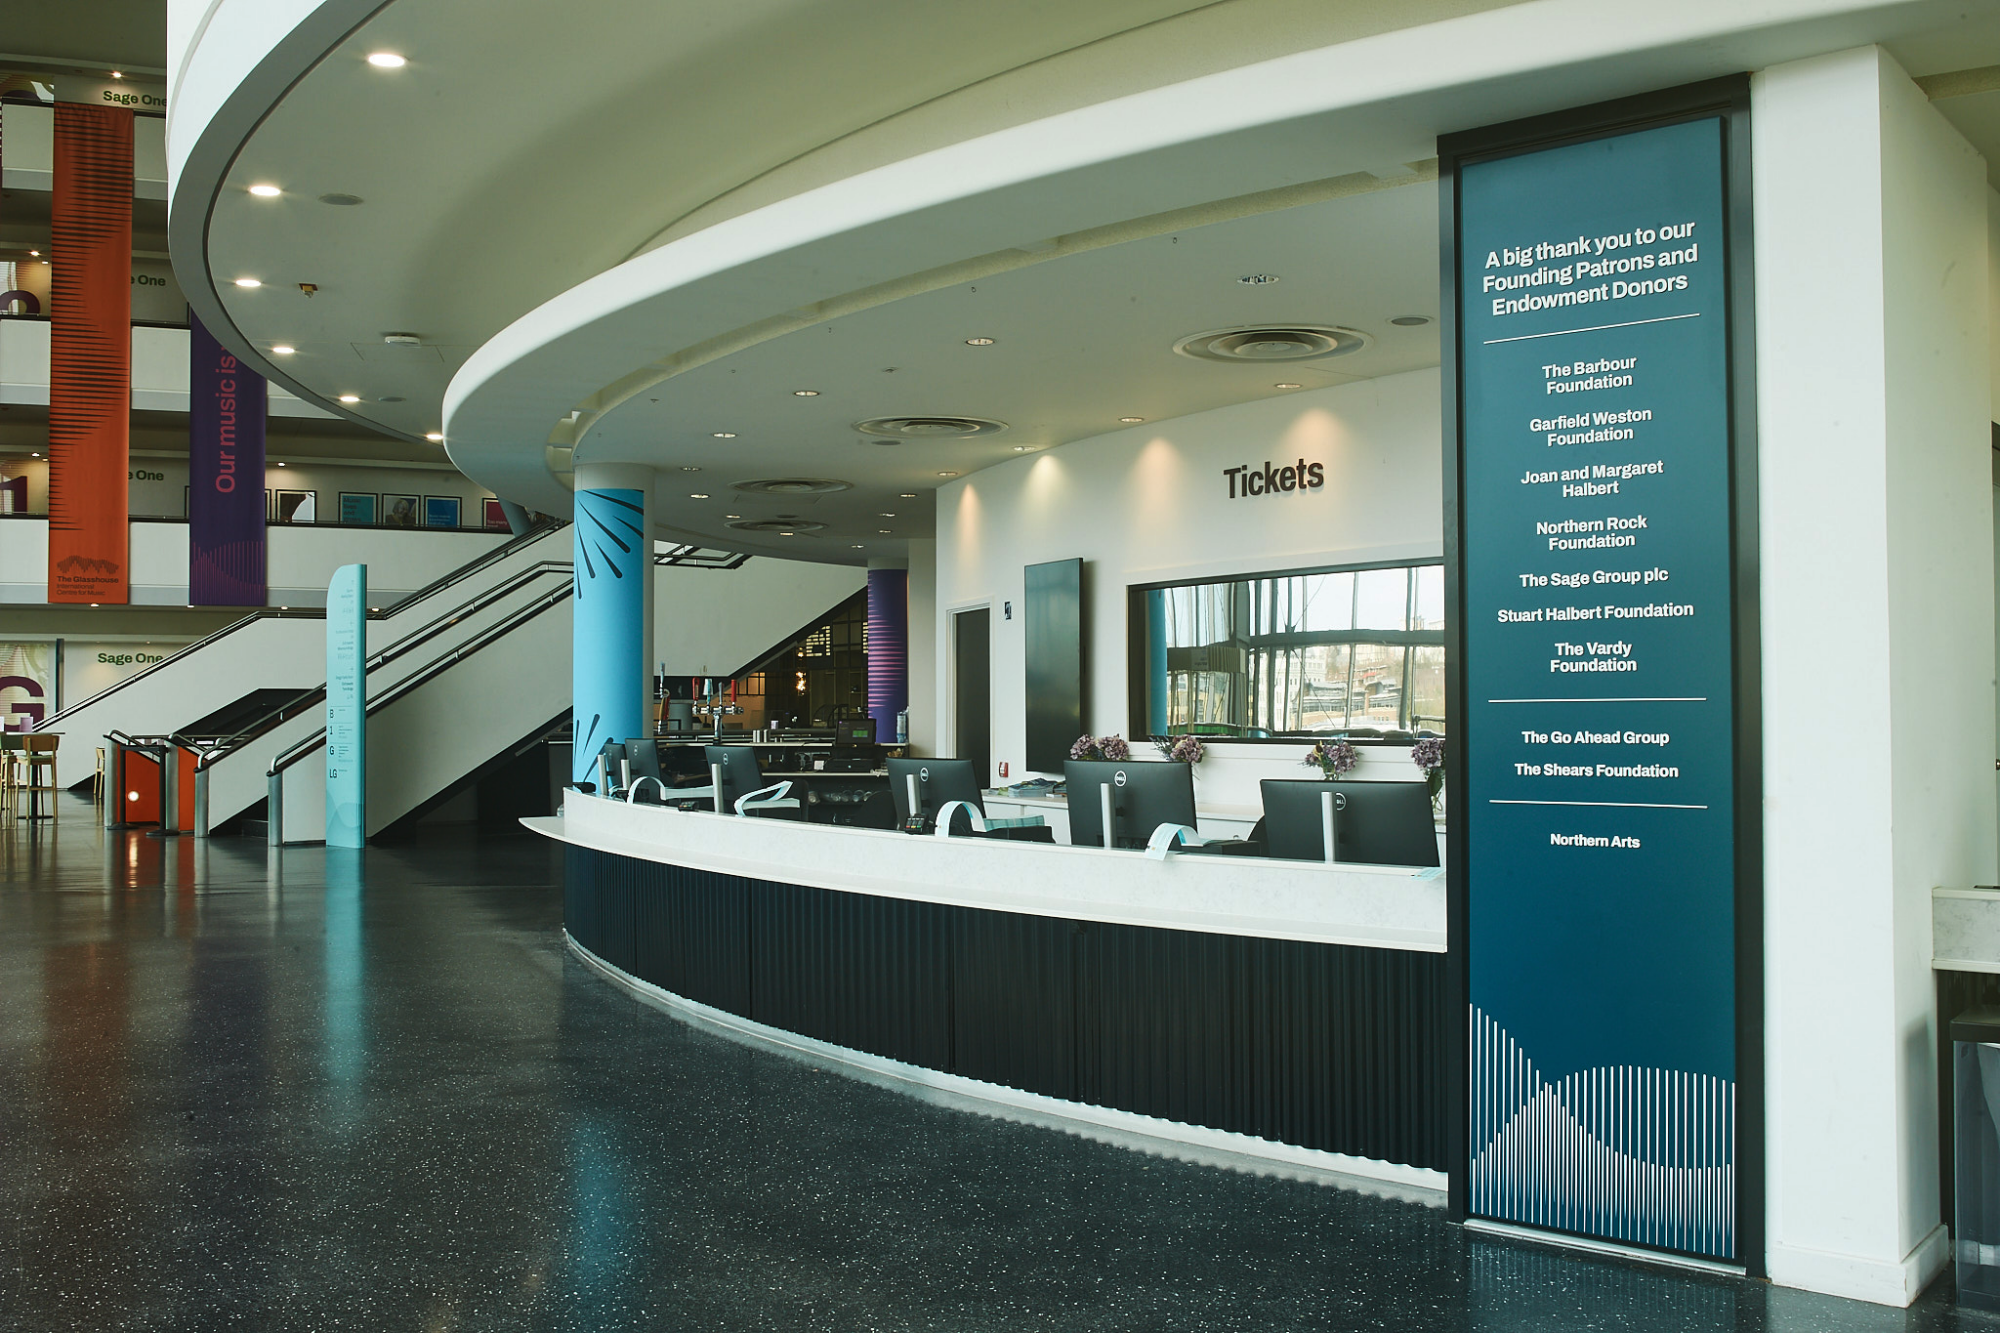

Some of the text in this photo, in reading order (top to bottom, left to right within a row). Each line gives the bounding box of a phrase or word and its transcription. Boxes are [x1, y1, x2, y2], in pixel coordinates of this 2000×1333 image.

[103, 91, 138, 105] Sage
[1485, 222, 1695, 268] A big thank you to our
[1484, 243, 1697, 292] Founding Patrons and
[138, 275, 166, 286] One
[1493, 275, 1687, 315] Endowment Donors
[1542, 358, 1636, 378] The Barbour
[1547, 374, 1632, 394] Foundation
[215, 355, 237, 493] Our music is
[1530, 410, 1651, 431] Garfield Weston
[1548, 427, 1633, 446] Foundation
[136, 470, 164, 481] One
[1223, 458, 1324, 499] Tickets
[1521, 460, 1663, 484] Joan and Margaret
[1563, 481, 1619, 497] Halbert
[1537, 515, 1647, 534] Northern Rock
[1549, 533, 1635, 550] Foundation
[73, 576, 119, 584] Glasshouse
[1519, 567, 1668, 587] The Sage Group plc
[1498, 603, 1693, 622] Stuart Halbert Foundation
[1555, 641, 1632, 657] The Vardy
[98, 652, 133, 666] Sage
[1551, 658, 1636, 672] Foundation
[330, 709, 334, 718] B
[1522, 731, 1669, 746] The Go Ahead Group
[330, 745, 335, 755] G
[330, 768, 337, 779] LG
[1515, 763, 1678, 777] The Shears Foundation
[1551, 834, 1640, 848] Northern Arts
